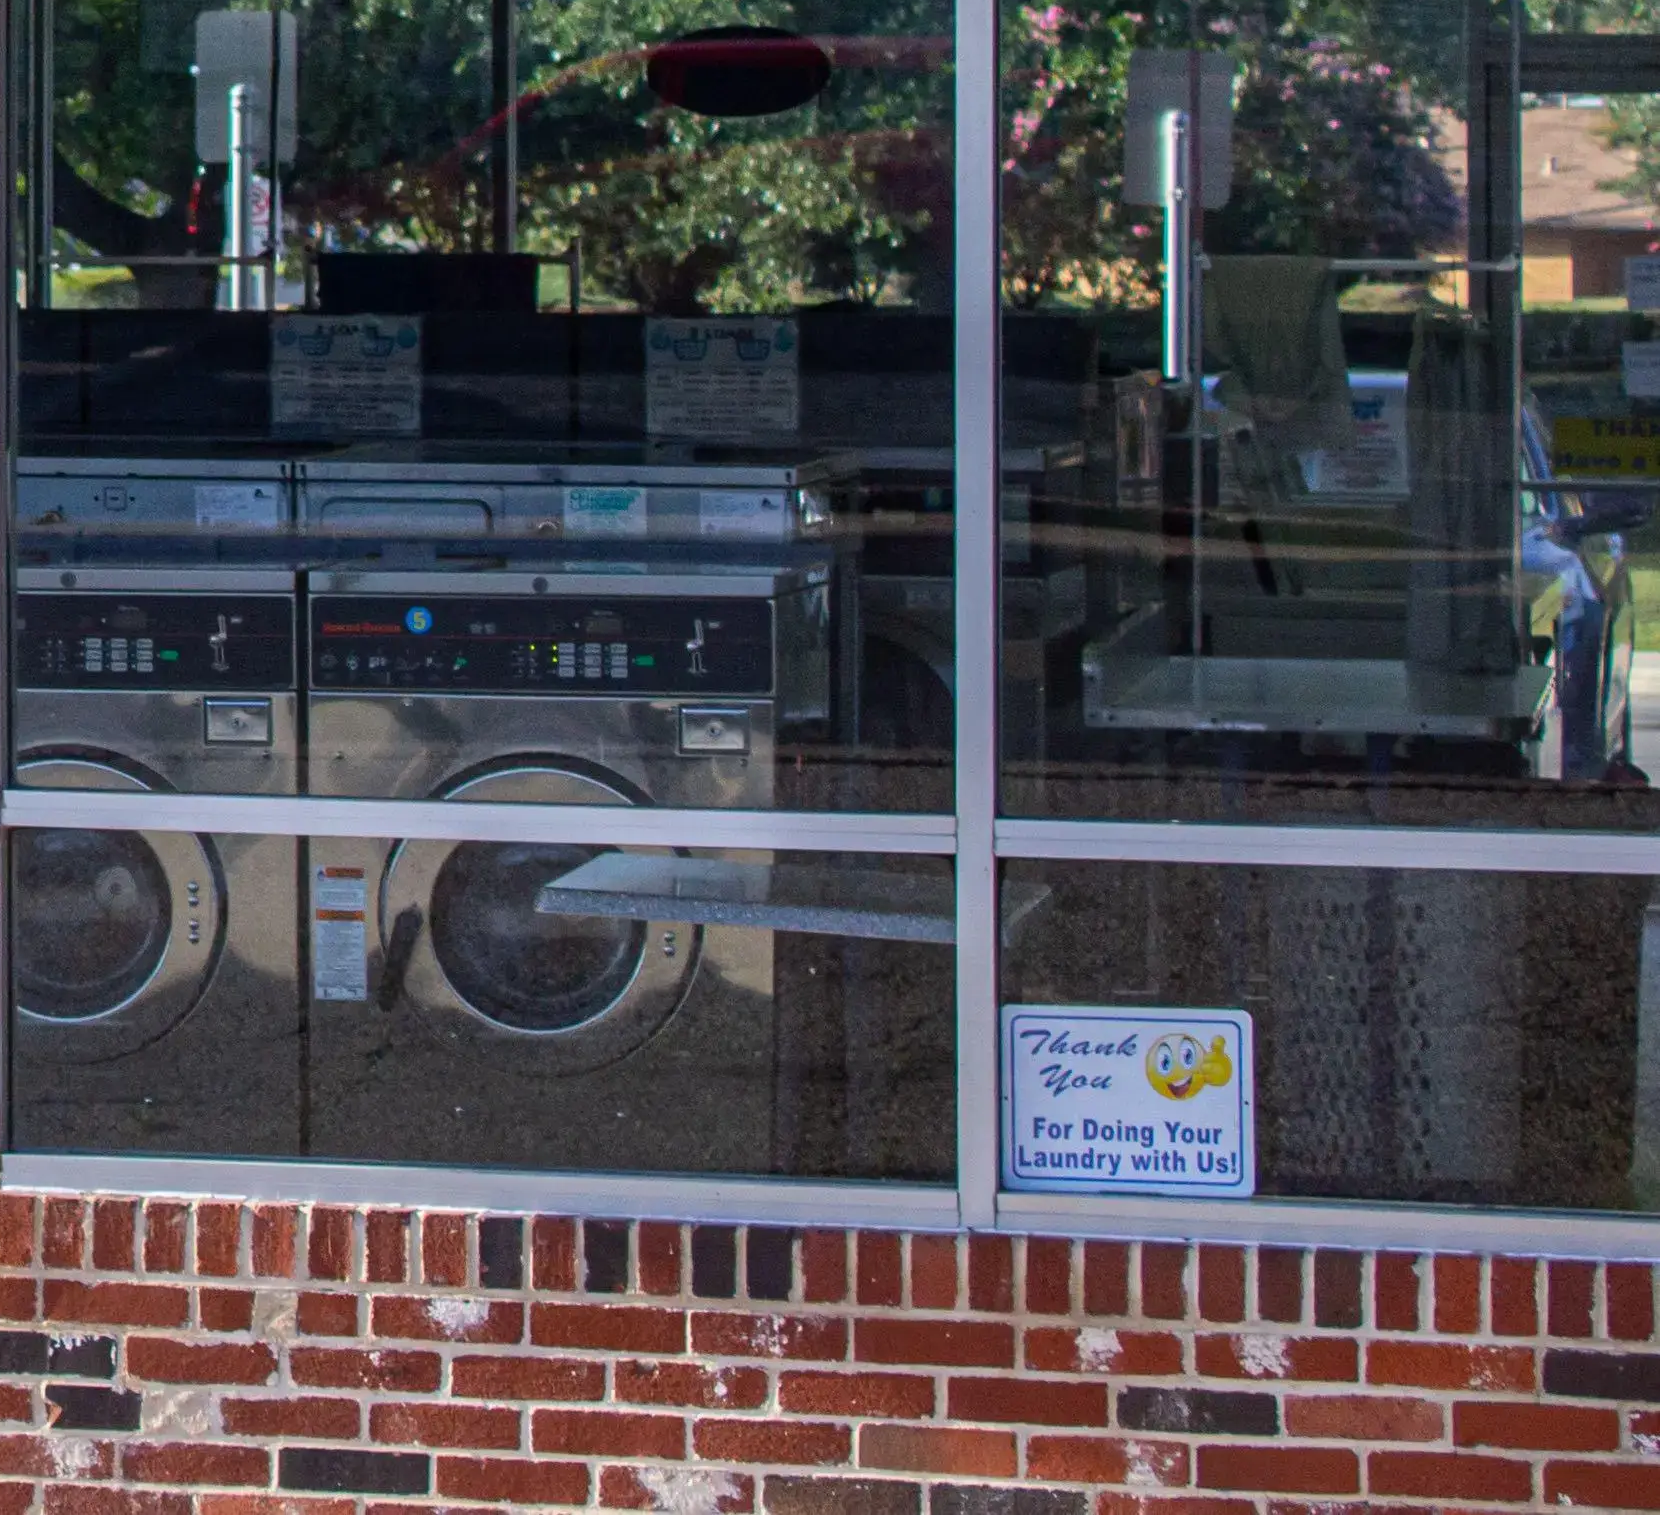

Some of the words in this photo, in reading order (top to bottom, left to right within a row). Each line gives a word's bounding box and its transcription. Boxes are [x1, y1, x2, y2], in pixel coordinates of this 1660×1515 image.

[413, 612, 426, 629] 5
[1019, 1029, 1139, 1056] Thank
[1039, 1063, 1113, 1097] You
[1032, 1116, 1073, 1140] For
[1082, 1118, 1155, 1148] Doing
[1164, 1121, 1223, 1145] Your
[1018, 1145, 1122, 1176] Laundry
[1130, 1150, 1186, 1173] with
[1196, 1151, 1238, 1174] Us!
